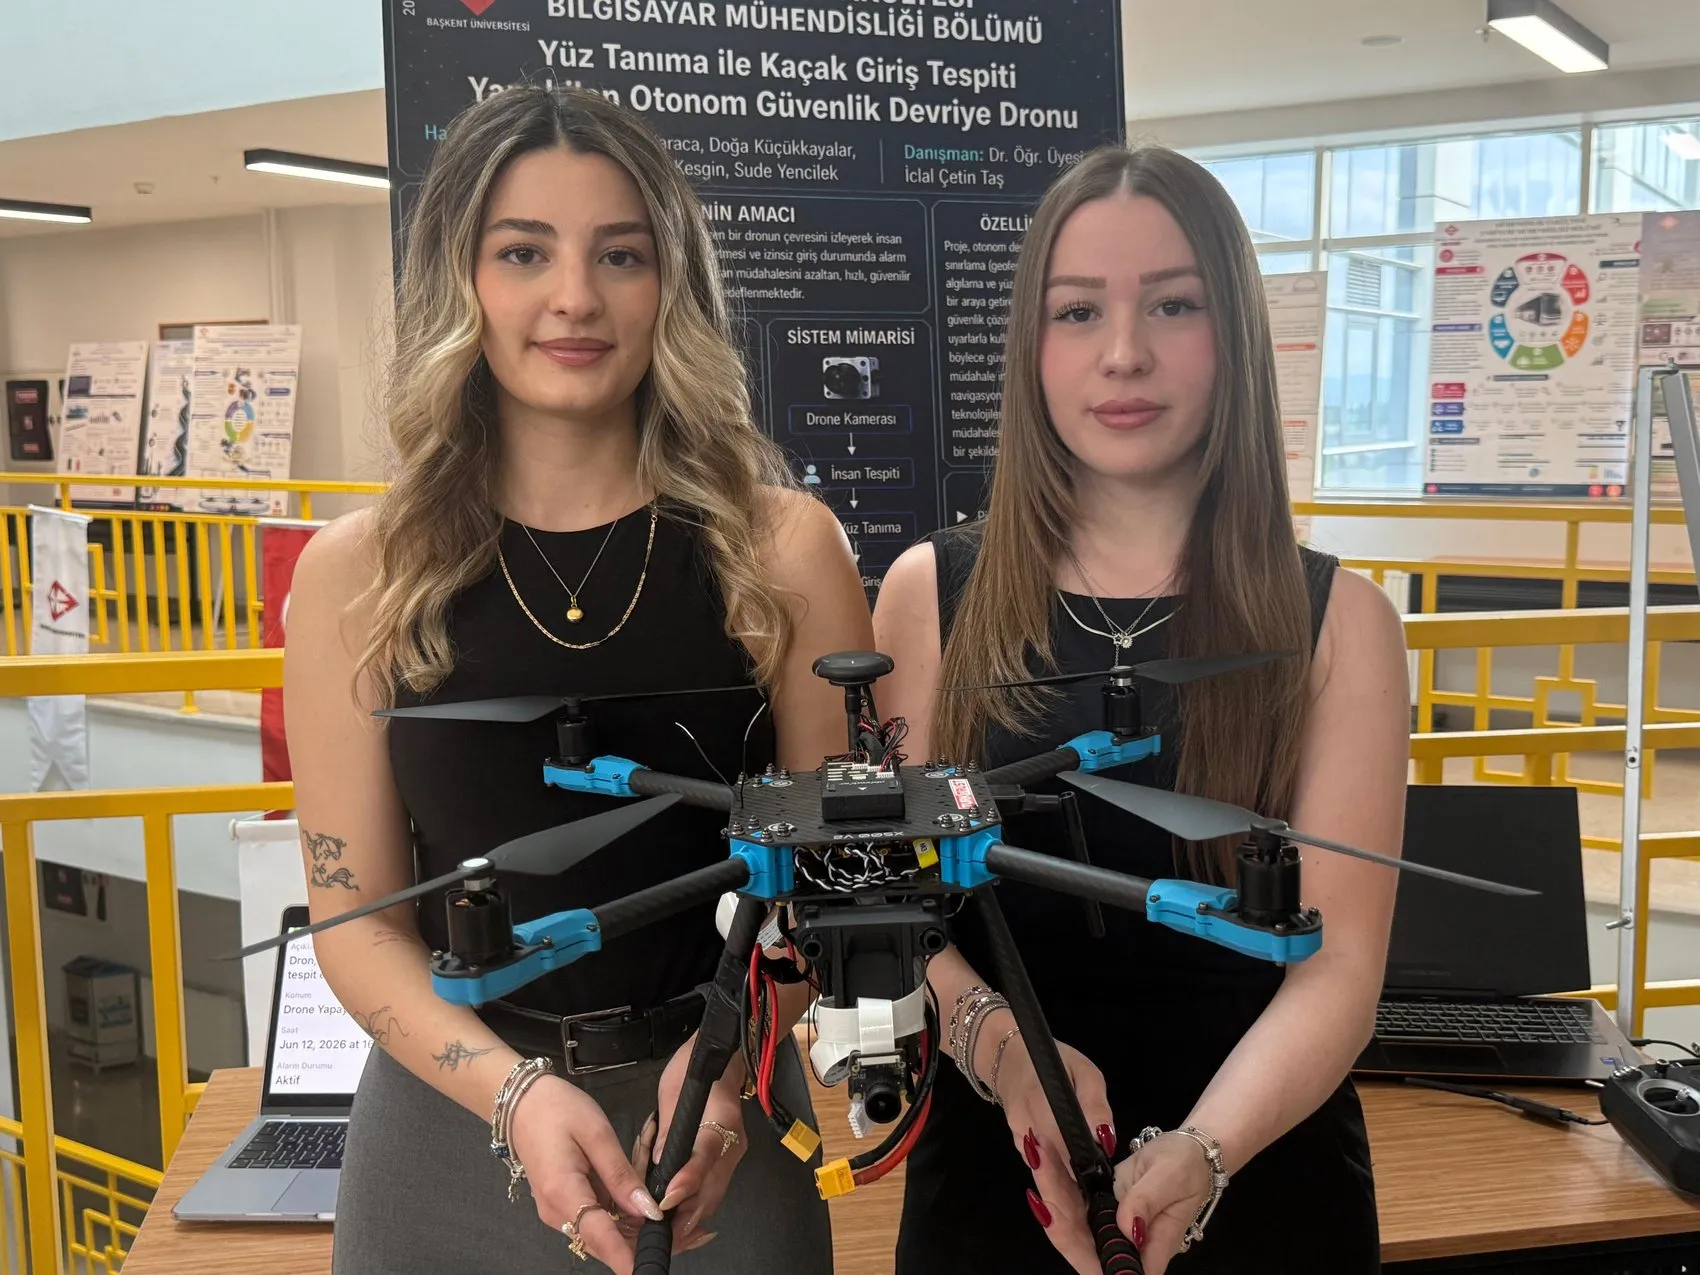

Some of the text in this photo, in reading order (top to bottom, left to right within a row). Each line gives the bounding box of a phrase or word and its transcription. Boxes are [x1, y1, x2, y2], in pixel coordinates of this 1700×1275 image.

[426, 17, 530, 32] BAŞKENT ÜNİVERSİTESİ
[725, 0, 924, 38] MÜHENDİSLİĞİ
[933, 11, 1043, 44] BÖLÜMÜ
[537, 39, 1017, 94] Yüz Tanıma ile Kaçak Giriş Tespiti
[630, 84, 748, 116] Otonom
[756, 91, 881, 123] Güvenlik
[889, 97, 992, 132] Devriye
[1000, 101, 1079, 130] Dronu
[655, 137, 857, 161] araca, Doğa Küçükkayalar,
[904, 144, 984, 164] Danışman:
[988, 147, 1009, 162] Dr.
[1013, 145, 1043, 168] Öğr.
[674, 159, 839, 181] Kesgin, Sude Yencilek
[904, 165, 1005, 189] İclal Çetin Taş
[738, 205, 796, 223] AMACI
[980, 213, 1033, 231] ÖZELLİ
[728, 229, 742, 241] bir
[744, 230, 781, 242] dronun
[783, 231, 828, 245] çevresini
[830, 231, 874, 246] izleyerek
[876, 233, 902, 244] insan
[944, 240, 970, 254] Proje,
[972, 242, 1006, 253] otonom
[749, 250, 761, 260] ve
[763, 248, 794, 261] izinsiz
[796, 249, 818, 264] giriş
[820, 249, 877, 262] durumunda
[878, 251, 907, 263] alarm
[736, 267, 802, 280] müdahalesini
[804, 269, 842, 282] azaltan,
[985, 281, 997, 289] ve
[946, 295, 959, 307] bir
[961, 298, 986, 309] araya
[947, 314, 985, 327] güvenlik
[787, 326, 915, 345] SİSTEM MİMARİSİ
[949, 351, 985, 365] böylece
[949, 370, 996, 382] müdahale
[806, 412, 897, 426] Drone Kamerası
[953, 445, 966, 457] bir
[831, 466, 900, 482] İnsan Tespiti
[862, 522, 902, 535] Tanıma
[288, 969, 317, 981] tespit
[284, 991, 312, 999] Konum
[283, 1005, 315, 1014] Drone
[281, 1026, 299, 1034] Saat
[279, 1039, 374, 1051] Jun 12, 2026 at 16
[276, 1062, 333, 1070] Alarm Durumu
[275, 1075, 301, 1085] Aktif
